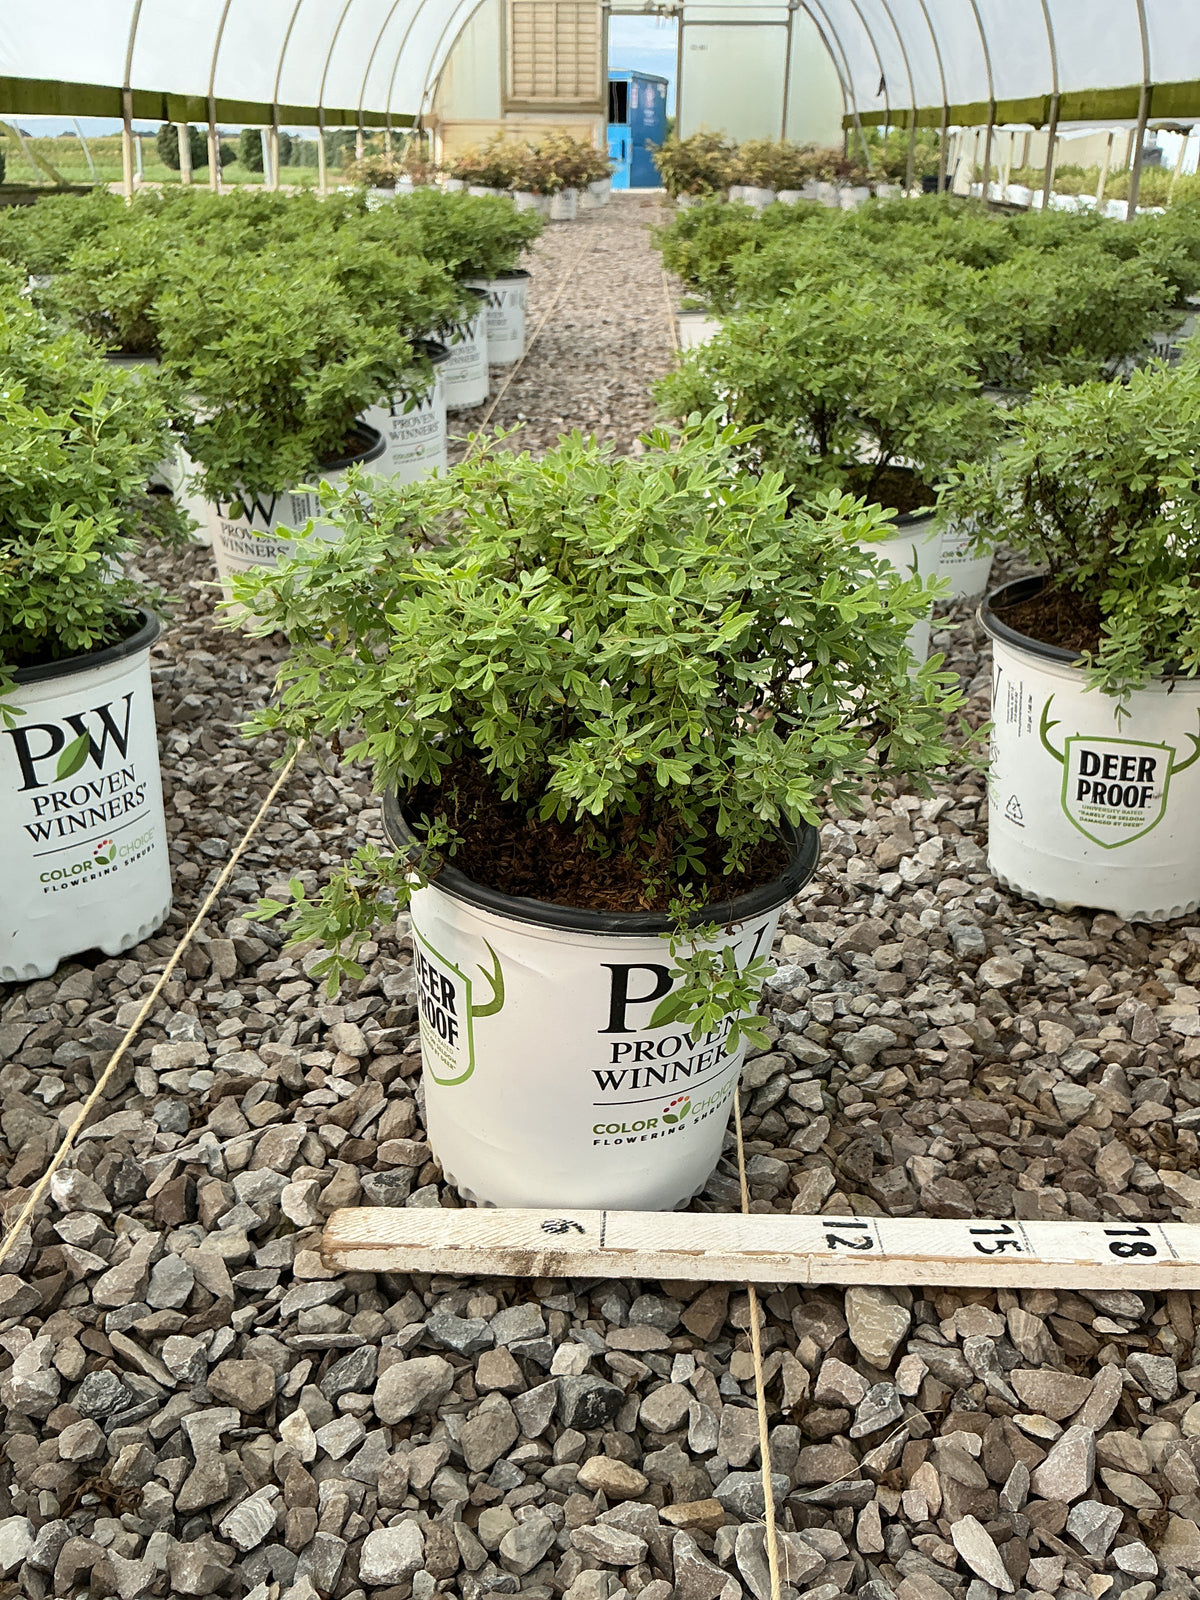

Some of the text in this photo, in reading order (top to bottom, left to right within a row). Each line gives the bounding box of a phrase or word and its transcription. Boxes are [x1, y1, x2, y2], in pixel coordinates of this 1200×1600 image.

[1, 691, 135, 792] PW
[1079, 749, 1158, 783] DEER
[30, 763, 136, 817] PROVEN
[1076, 778, 1154, 809] PROOF
[23, 783, 146, 843] WINNERS
[39, 829, 155, 884] COLOR CHOICE
[43, 865, 119, 894] FLOWERING
[591, 1041, 730, 1091] WINNER
[592, 1117, 659, 1136] COLOR
[593, 1124, 686, 1147] FLOWERING
[822, 1218, 874, 1250] 12
[969, 1223, 1024, 1255] 15
[1103, 1225, 1158, 1258] 18
